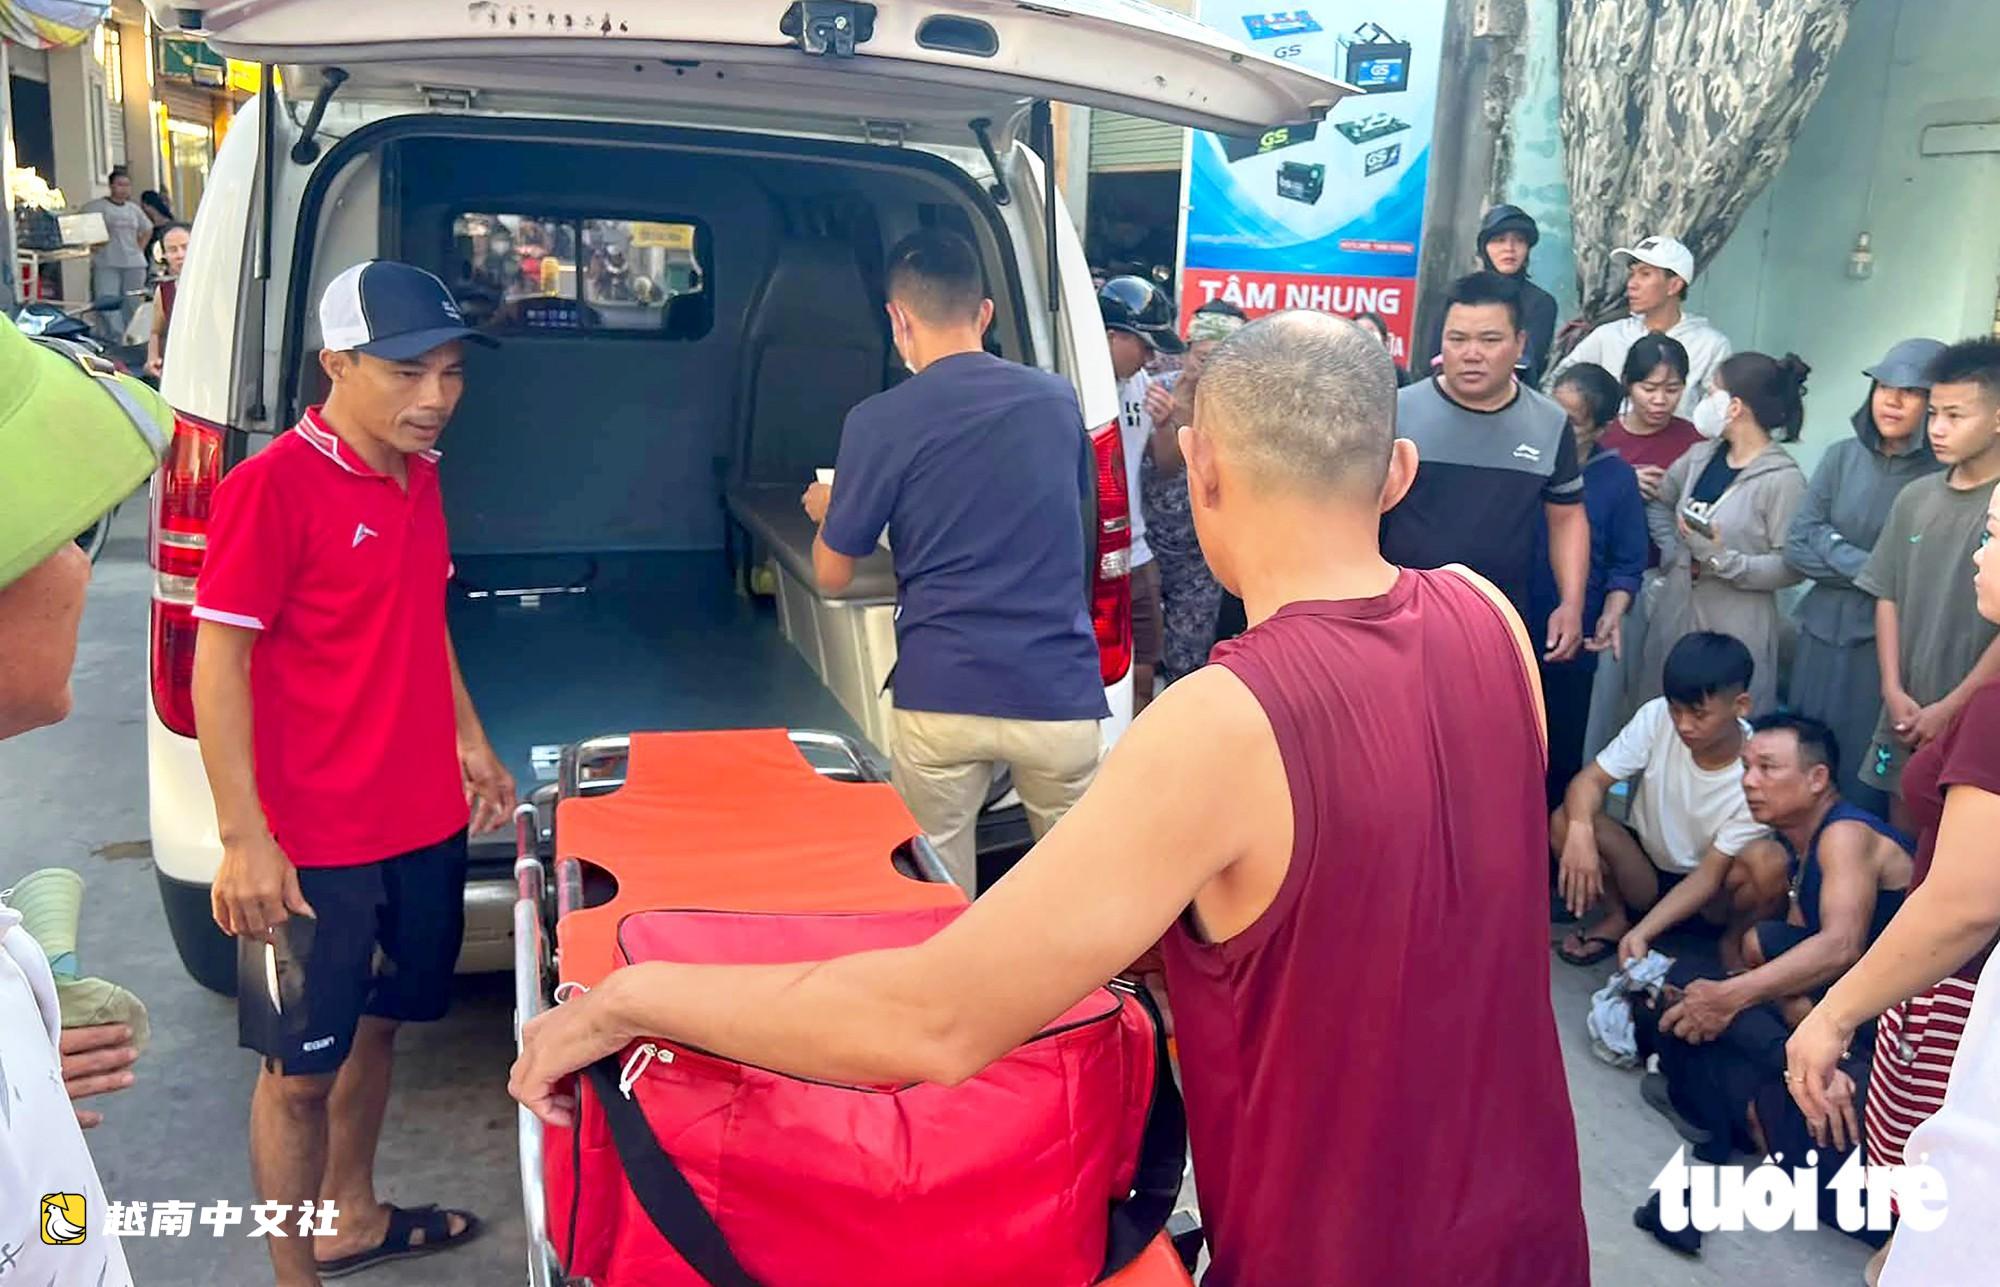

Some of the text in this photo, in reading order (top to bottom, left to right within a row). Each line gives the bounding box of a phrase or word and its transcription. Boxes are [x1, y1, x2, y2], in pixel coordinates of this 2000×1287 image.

[1274, 45, 1302, 59] GS
[1370, 64, 1390, 76] GS
[1261, 128, 1289, 146] GS
[1199, 275, 1401, 315] TÂM NHUNG
